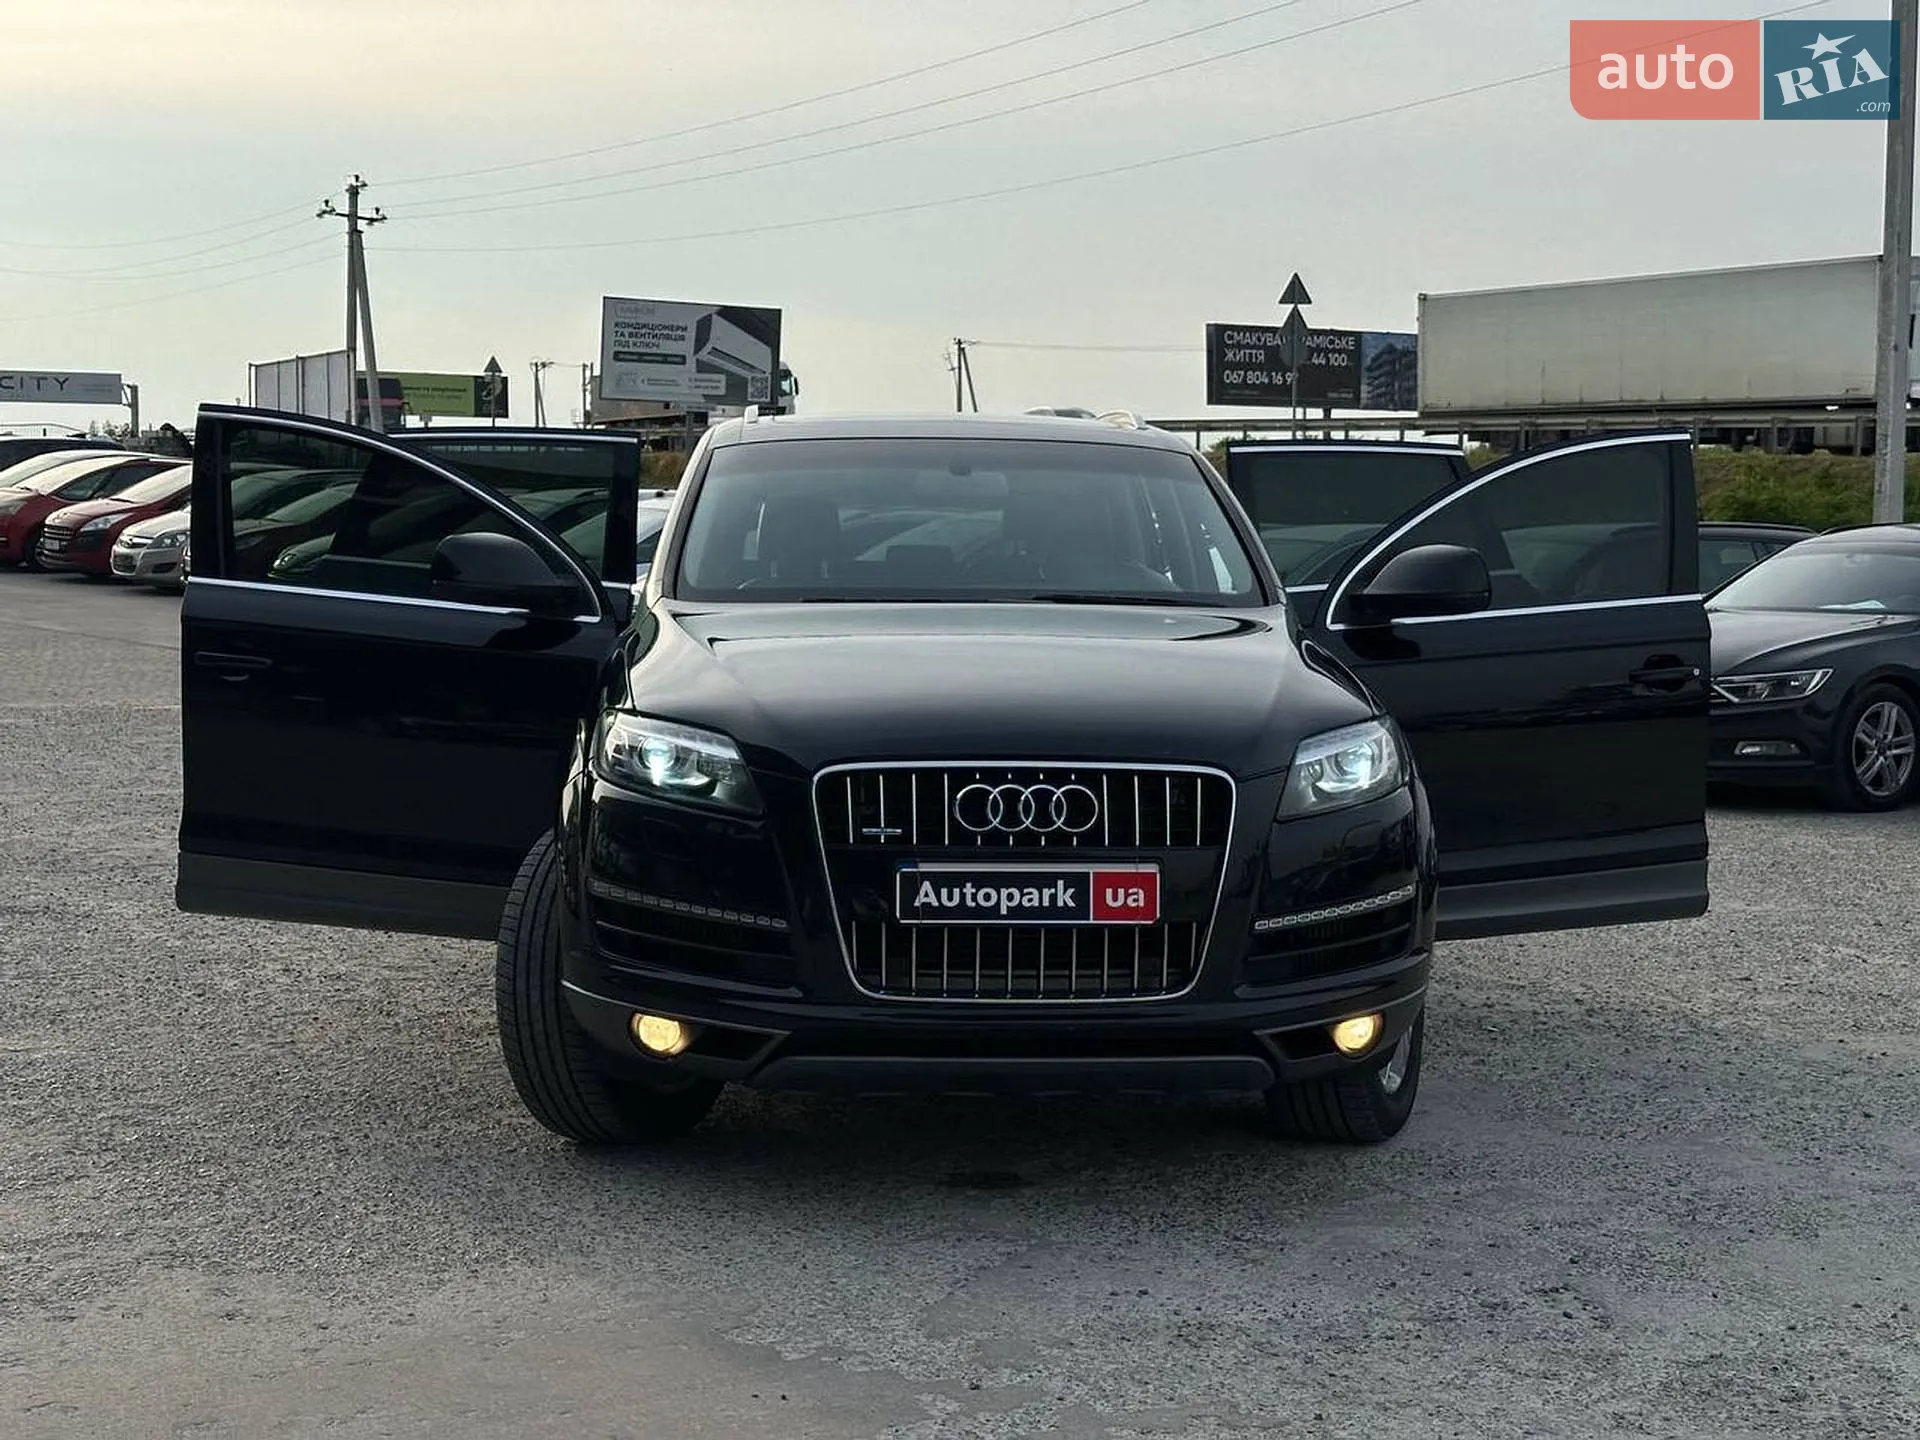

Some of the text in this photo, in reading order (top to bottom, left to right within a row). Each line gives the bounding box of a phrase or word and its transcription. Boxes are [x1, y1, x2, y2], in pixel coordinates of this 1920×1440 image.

[613, 330, 626, 338] ТА
[1224, 331, 1286, 346] СМАКУВА
[1224, 348, 1264, 363] ЖИТТЯ
[1311, 352, 1347, 367] 44 100
[1224, 370, 1244, 383] 067
[1246, 370, 1269, 385] 804
[1271, 371, 1284, 385] 16
[914, 880, 1146, 915] Autopark ua
